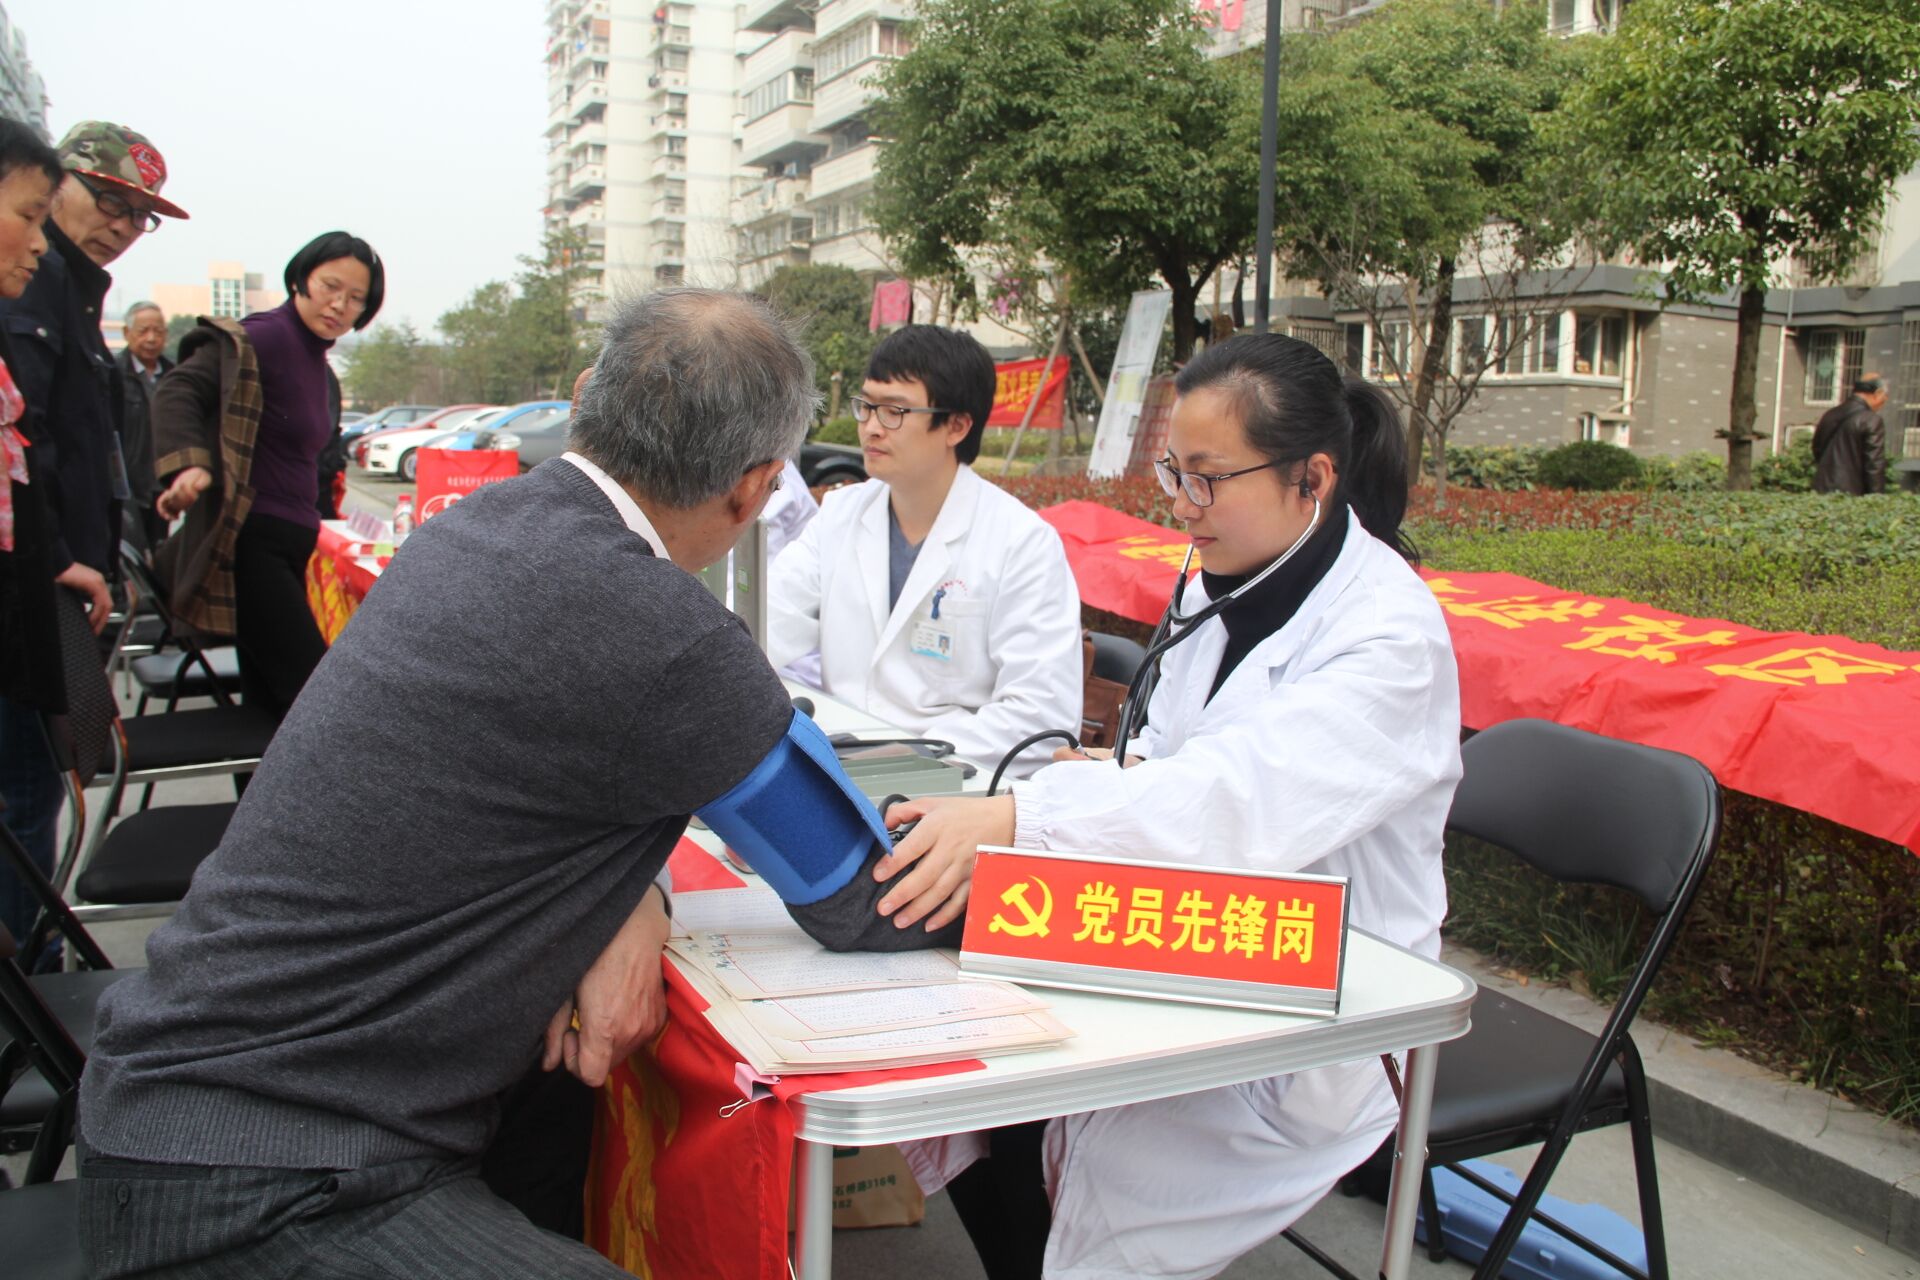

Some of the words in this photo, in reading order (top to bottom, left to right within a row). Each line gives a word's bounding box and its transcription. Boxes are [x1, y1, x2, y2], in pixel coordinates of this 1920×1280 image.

[1072, 880, 1316, 964] 党员先锋岗
